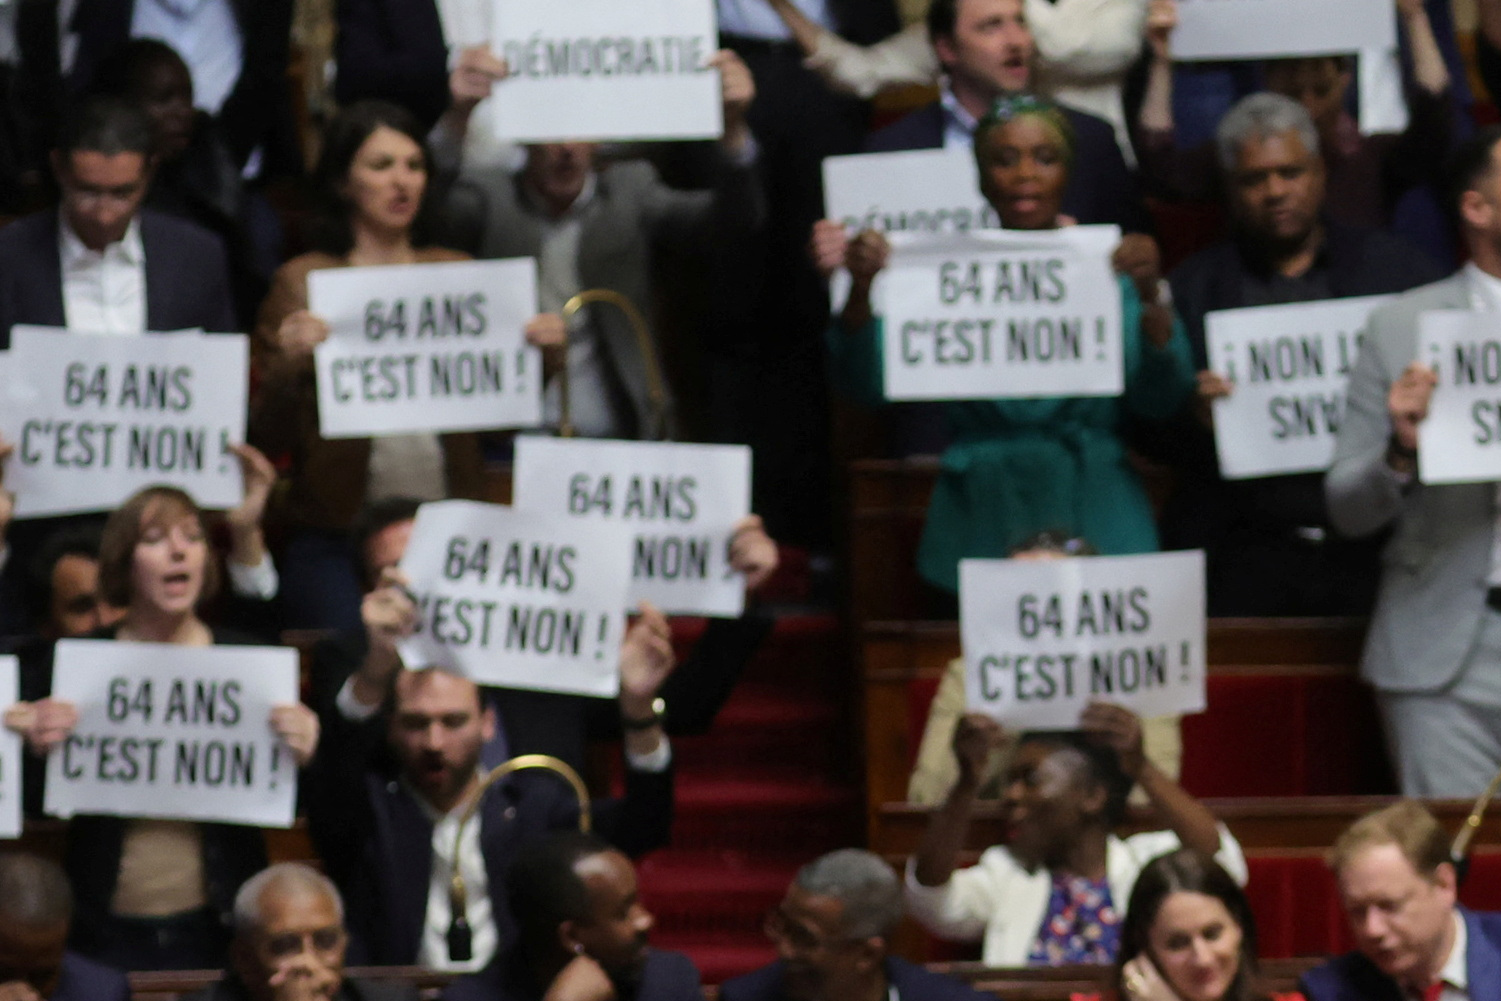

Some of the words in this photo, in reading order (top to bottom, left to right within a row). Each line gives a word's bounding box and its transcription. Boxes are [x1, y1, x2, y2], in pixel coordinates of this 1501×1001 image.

[504, 30, 707, 78] DÉMOCRATIE
[939, 264, 983, 306] 64
[993, 259, 1067, 304] ANS
[361, 300, 409, 343] 64
[416, 292, 487, 338] ANS
[901, 319, 992, 367] C'EST
[1008, 318, 1082, 363] NON
[1094, 316, 1106, 362] !
[331, 352, 418, 404] C'EST
[431, 351, 502, 396] NON
[514, 350, 527, 394] !
[1249, 336, 1324, 384] NON
[65, 363, 108, 407] 64
[119, 365, 191, 412] ANS
[1268, 395, 1345, 440] ANS
[21, 419, 116, 470] C'EST
[128, 425, 204, 472] NON
[219, 426, 230, 474] !
[568, 473, 613, 517] 64
[624, 476, 696, 522] ANS
[444, 536, 491, 582] 64
[501, 540, 575, 594] ANS
[633, 536, 711, 581] NON
[506, 605, 584, 657] NON
[595, 614, 608, 660] !
[1017, 594, 1062, 640] 64
[1077, 588, 1151, 636] ANS
[978, 654, 1077, 703] C'EST
[1089, 647, 1167, 695] NON
[1180, 639, 1191, 684] !
[107, 679, 152, 723] 64
[164, 680, 241, 728] ANS
[62, 732, 161, 784] C'EST
[175, 741, 254, 786] NON
[269, 742, 280, 790] !
